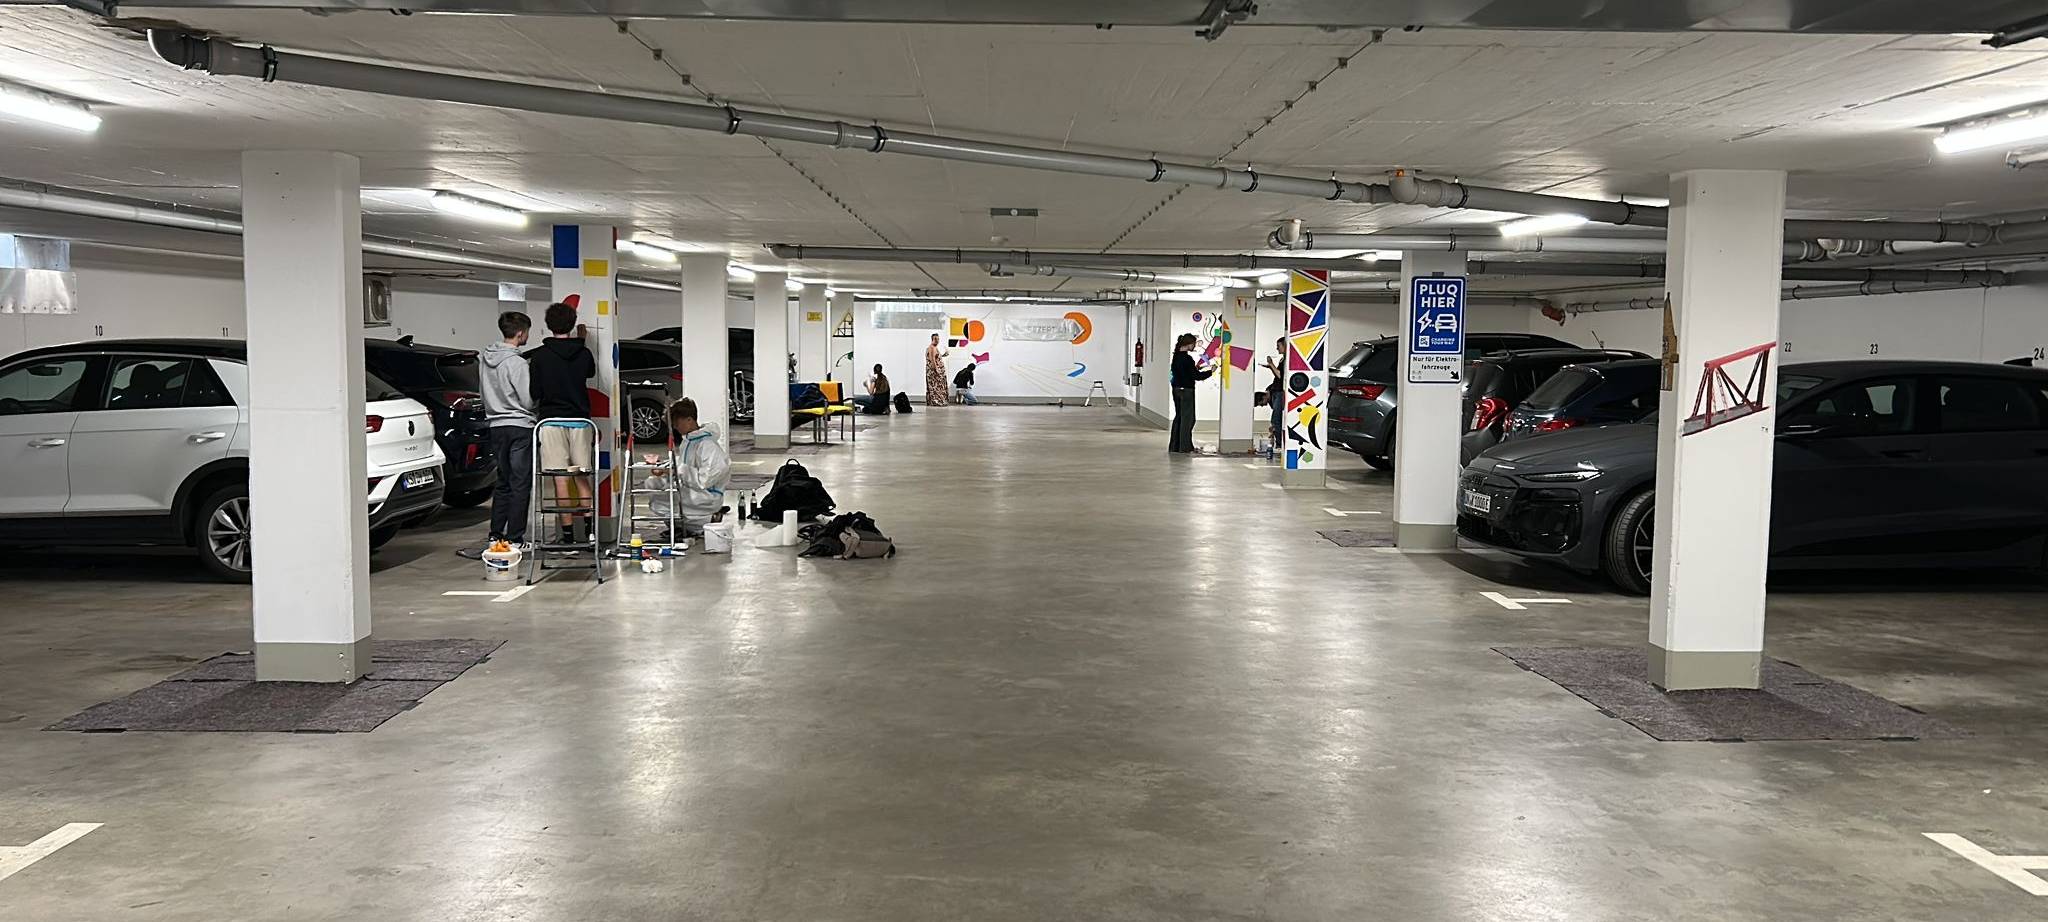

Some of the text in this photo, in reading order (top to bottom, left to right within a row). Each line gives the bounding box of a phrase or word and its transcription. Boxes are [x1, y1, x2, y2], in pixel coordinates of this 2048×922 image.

[1420, 284, 1458, 298] PLUQ
[1421, 297, 1455, 308] HIER
[95, 325, 103, 336] 10
[222, 327, 229, 337] 11
[1784, 342, 1792, 353] 22
[1869, 343, 1879, 355] 23
[2033, 347, 2045, 361] 24
